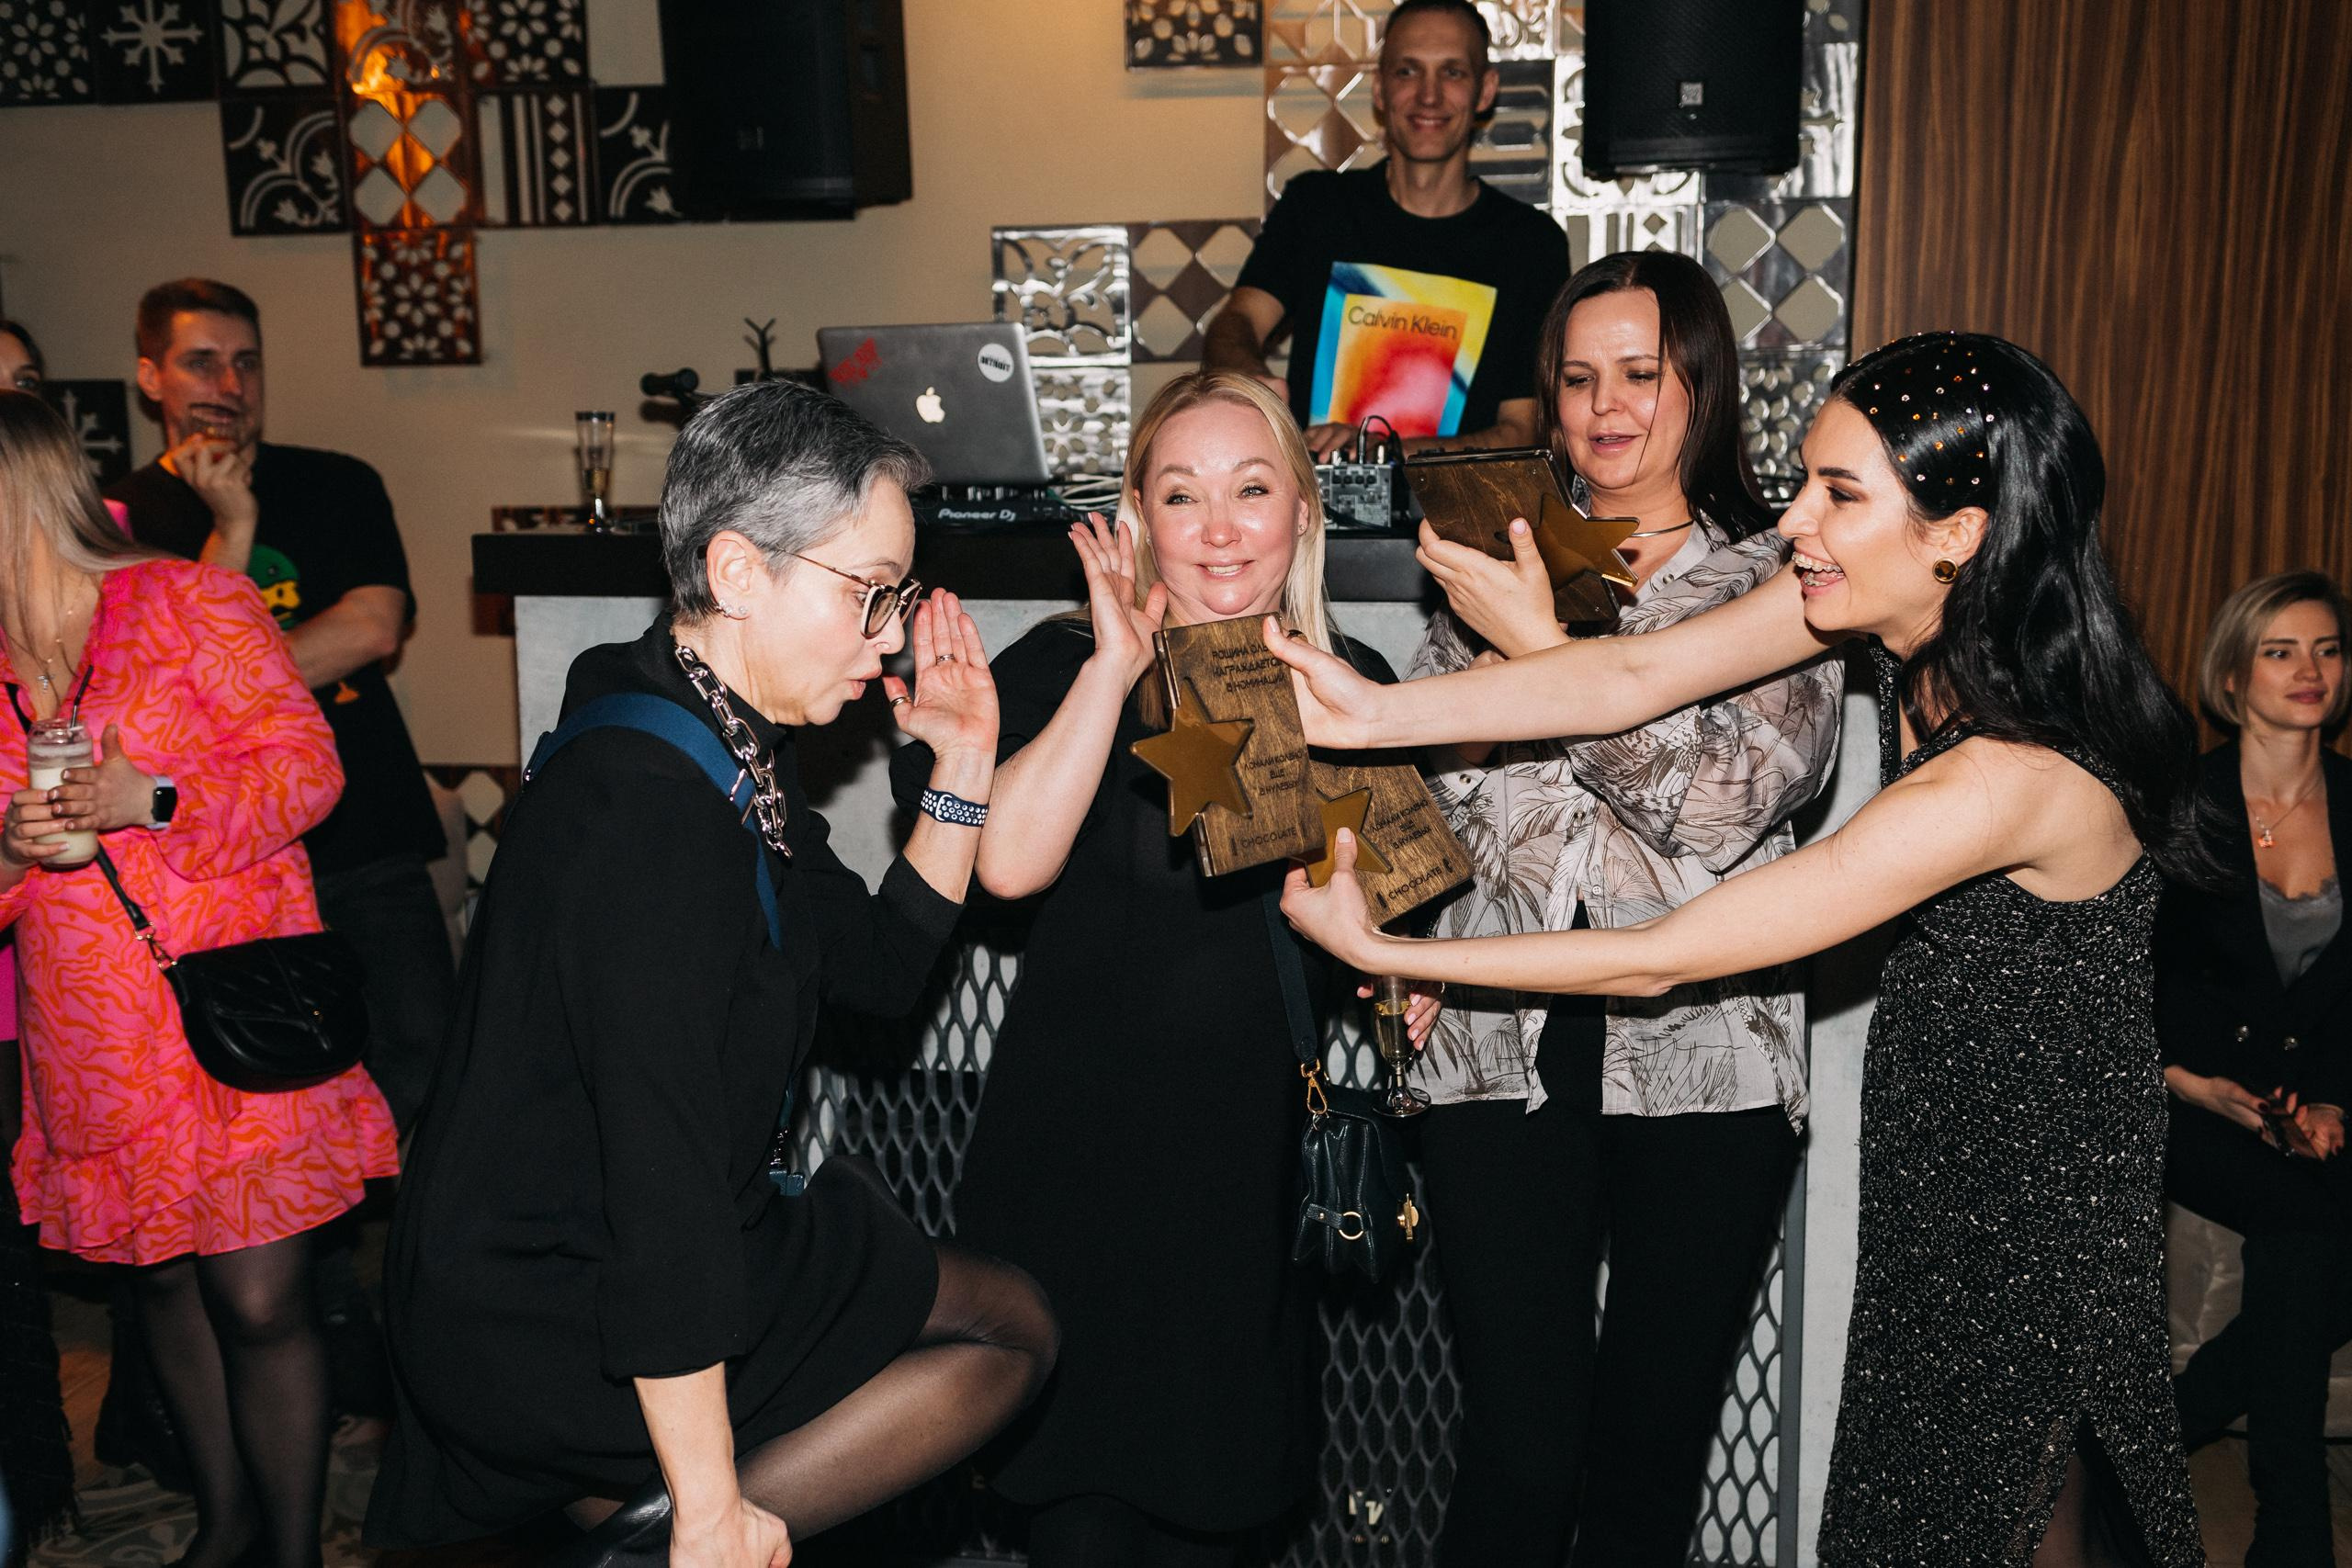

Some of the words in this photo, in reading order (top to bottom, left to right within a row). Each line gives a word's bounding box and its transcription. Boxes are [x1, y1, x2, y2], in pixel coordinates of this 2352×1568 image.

[1347, 305, 1408, 332] Calvin
[1410, 315, 1458, 339] Klein
[937, 507, 997, 520] Pioneer
[1250, 643, 1269, 654] ОЛЬ
[1226, 682, 1233, 693] В
[1244, 756, 1274, 771] ЛОМАЛИ
[1274, 751, 1303, 764] КОЛЕНО
[1259, 786, 1266, 796] В
[1241, 827, 1296, 848] CHOCOLATE
[1388, 867, 1442, 898] CHOCOLATE
